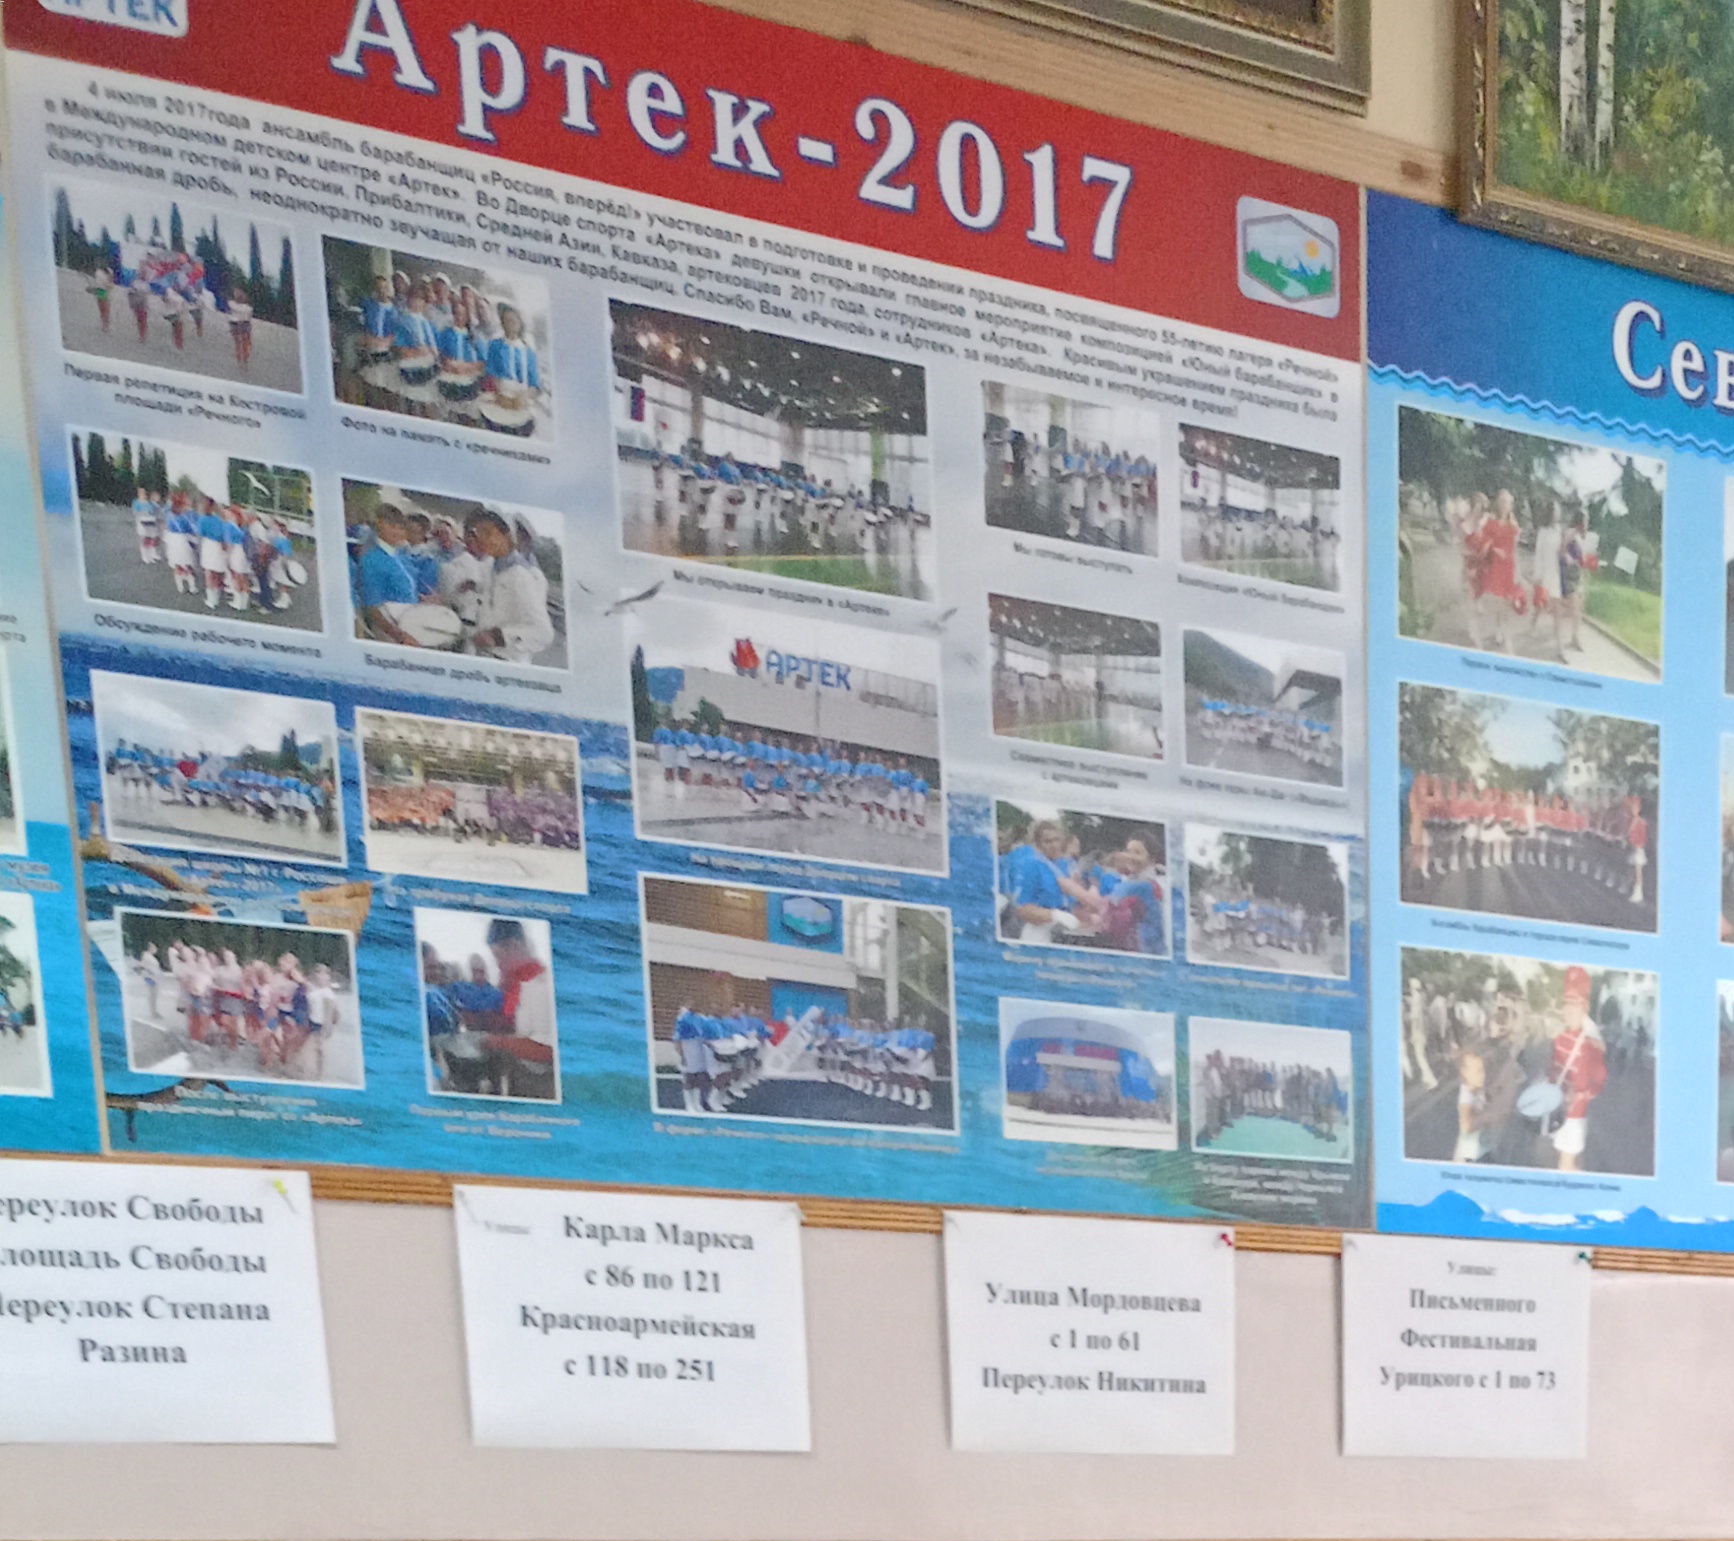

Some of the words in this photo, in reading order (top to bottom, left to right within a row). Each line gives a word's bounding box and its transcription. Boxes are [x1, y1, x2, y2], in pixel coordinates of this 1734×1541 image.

[329, 0, 1134, 263] Артек-2017
[45, 120, 173, 160] присутствии
[180, 149, 242, 174] гостей
[248, 165, 269, 181] из
[476, 212, 553, 244] Средней
[791, 284, 825, 307] 2017
[104, 85, 157, 109] июля
[261, 119, 355, 154] ансамбль
[360, 141, 476, 182] барабанщиц
[646, 210, 742, 244] участвовал
[749, 236, 758, 248] в
[763, 239, 853, 271] подготовке
[872, 263, 964, 296] проведении
[969, 288, 1050, 316] праздника,
[44, 98, 56, 113] в
[61, 98, 227, 149] Международном
[234, 138, 311, 168] детском
[317, 157, 380, 182] центре
[476, 189, 500, 210] Во
[505, 196, 571, 228] Дворце
[576, 216, 635, 242] спорта
[810, 271, 896, 301] открывали
[905, 293, 966, 317] главное
[975, 309, 1072, 341] мероприятие
[46, 139, 165, 180] барабанная
[249, 188, 383, 228] неоднократно
[389, 218, 477, 251] звучащая
[482, 240, 506, 256] от
[507, 245, 562, 269] наших
[683, 281, 756, 311] Спасибо
[964, 347, 979, 361] за
[208, 393, 224, 405] на
[340, 415, 376, 433] Фото
[380, 424, 396, 437] на
[766, 649, 851, 691] АРТЕК
[127, 1195, 264, 1224] Свободы
[563, 1215, 647, 1246] Карла
[655, 1222, 754, 1253] Маркса
[131, 1245, 267, 1273] Свободы
[585, 1268, 597, 1287] с
[605, 1264, 634, 1289] 86
[643, 1272, 673, 1292] по
[683, 1270, 721, 1293] 121
[143, 1295, 271, 1321] Степана
[985, 1281, 1060, 1308] Улица
[1067, 1286, 1202, 1315] Мордовцева
[1409, 1287, 1536, 1314] Письменного
[520, 1304, 756, 1341] Красноармейская
[79, 1338, 187, 1363] Разина
[1050, 1332, 1061, 1348] с
[1069, 1329, 1078, 1349] 1
[1086, 1334, 1112, 1351] по
[1118, 1331, 1141, 1352] 61
[1400, 1327, 1537, 1352] Фестивальная
[564, 1357, 578, 1377] с
[587, 1354, 629, 1379] 118
[637, 1362, 667, 1380] по
[676, 1359, 716, 1382] 251
[981, 1366, 1090, 1395] Переулок
[1098, 1370, 1207, 1395] Никитина
[1380, 1366, 1474, 1391] Урицкого
[1479, 1374, 1489, 1389] с
[1509, 1375, 1531, 1390] по
[1536, 1370, 1556, 1390] 73
